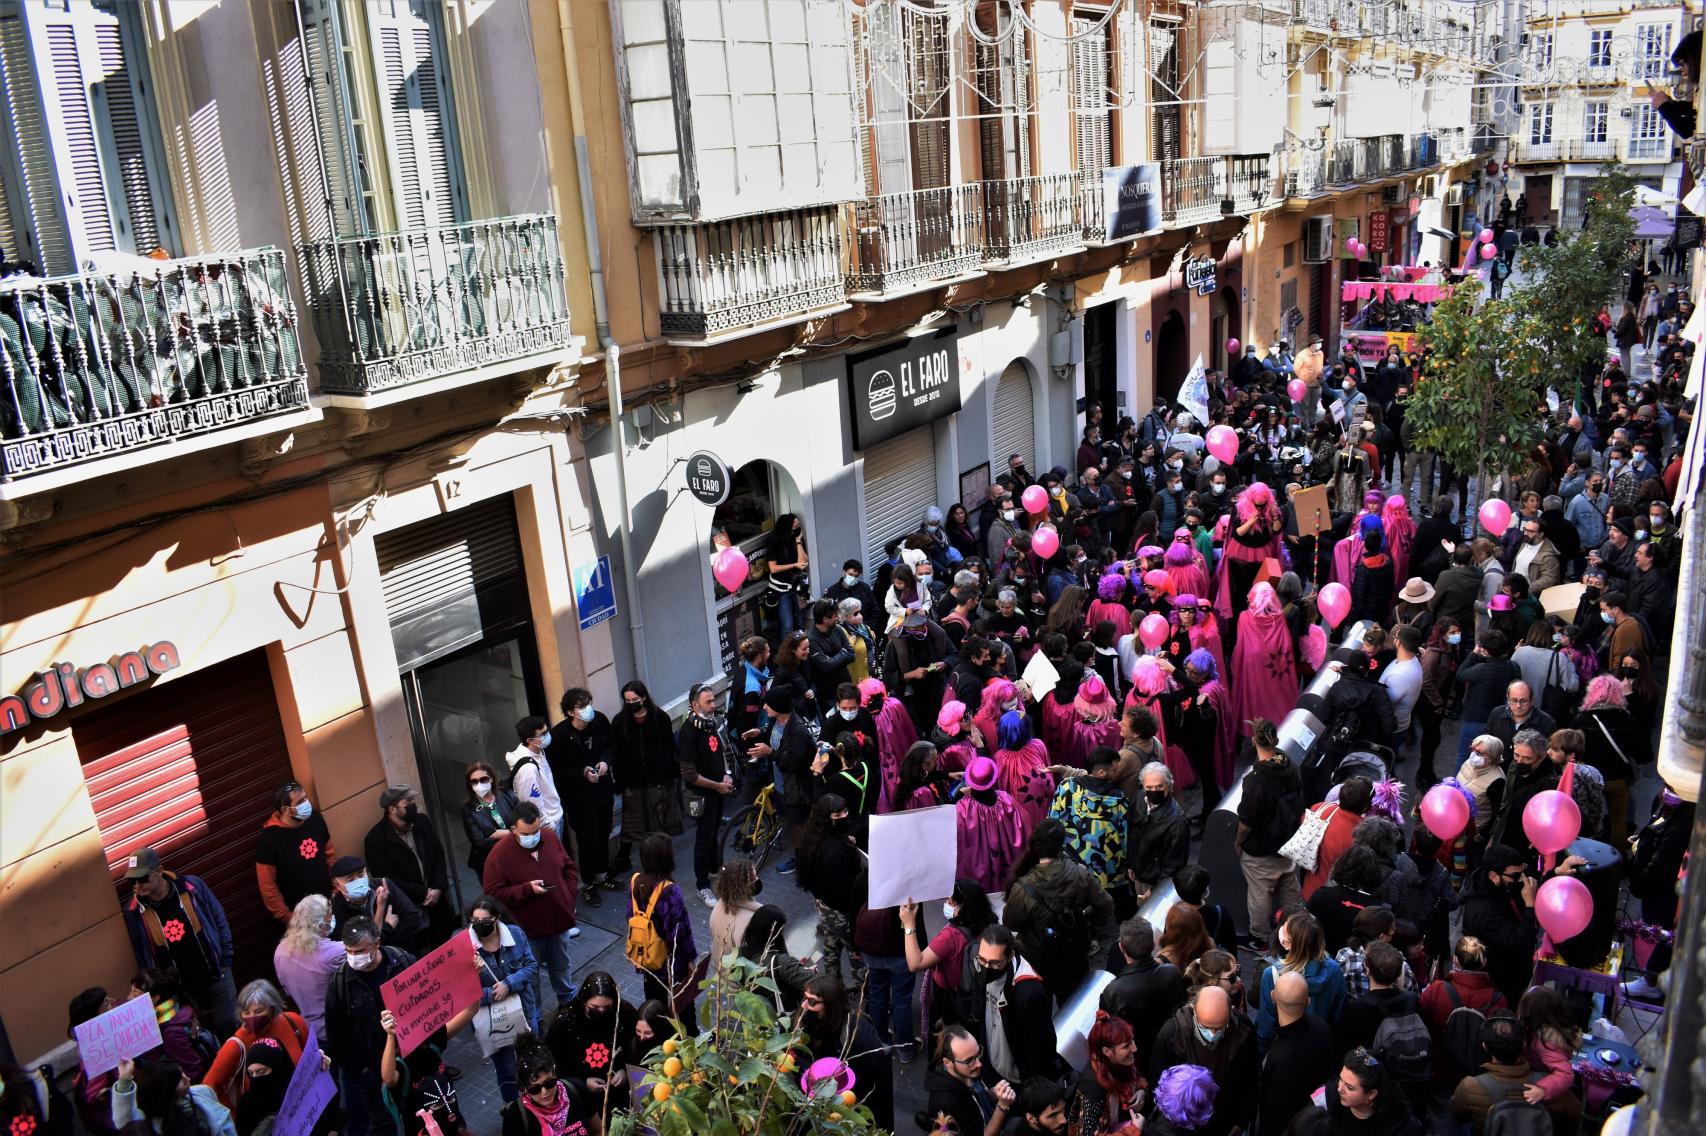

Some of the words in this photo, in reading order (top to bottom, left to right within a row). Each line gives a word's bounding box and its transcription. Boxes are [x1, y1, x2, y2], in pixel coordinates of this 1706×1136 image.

[900, 361, 916, 397] EL
[919, 349, 949, 390] FARO
[914, 395, 928, 406] DESDE
[929, 390, 940, 401] 2010
[692, 477, 701, 490] EL
[702, 478, 720, 493] FARO
[579, 560, 606, 596] AT
